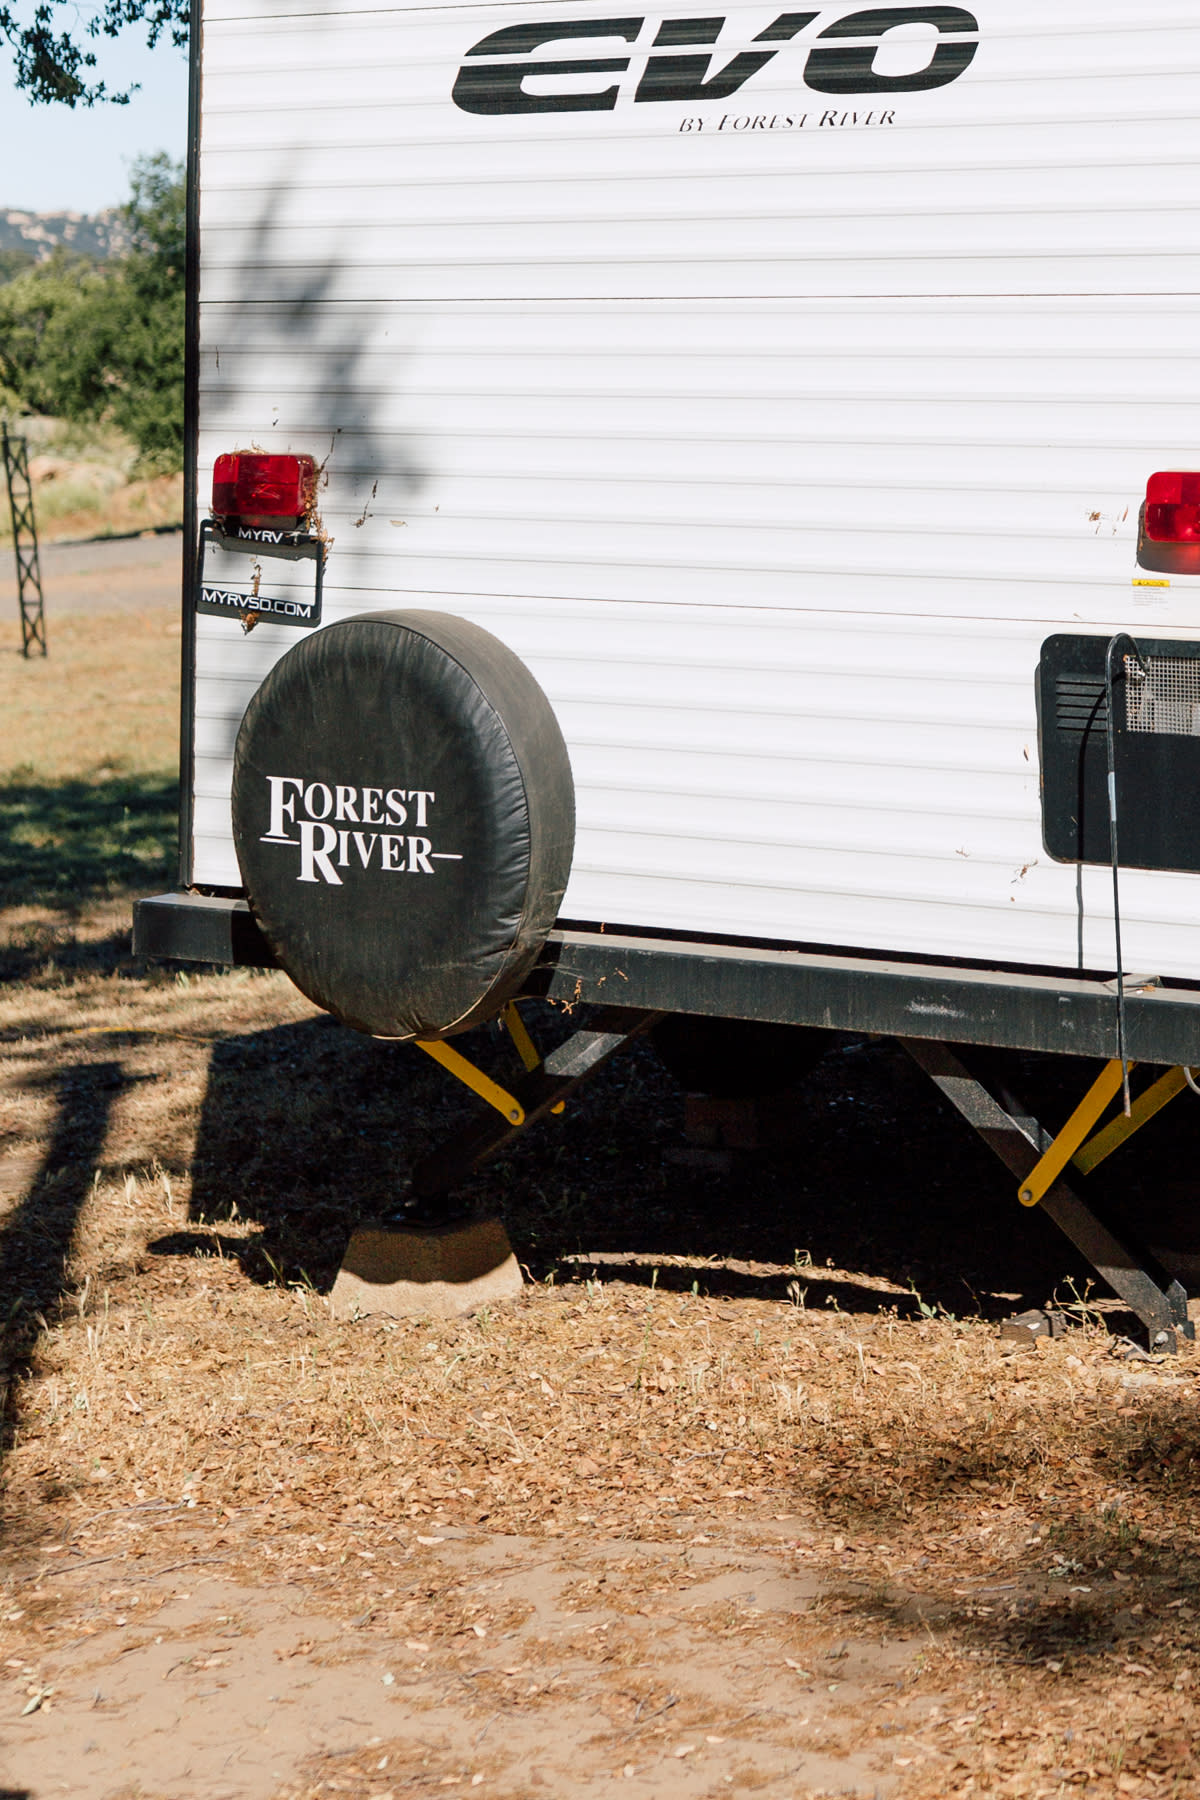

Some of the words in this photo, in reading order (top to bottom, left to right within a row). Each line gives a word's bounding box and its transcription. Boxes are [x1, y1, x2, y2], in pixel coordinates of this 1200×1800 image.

[452, 5, 979, 115] EVO
[679, 117, 711, 132] BY
[819, 109, 896, 127] RIVER
[202, 588, 312, 618] MYRVSD.COM
[265, 775, 435, 838] FOREST
[296, 820, 435, 886] RIVER
